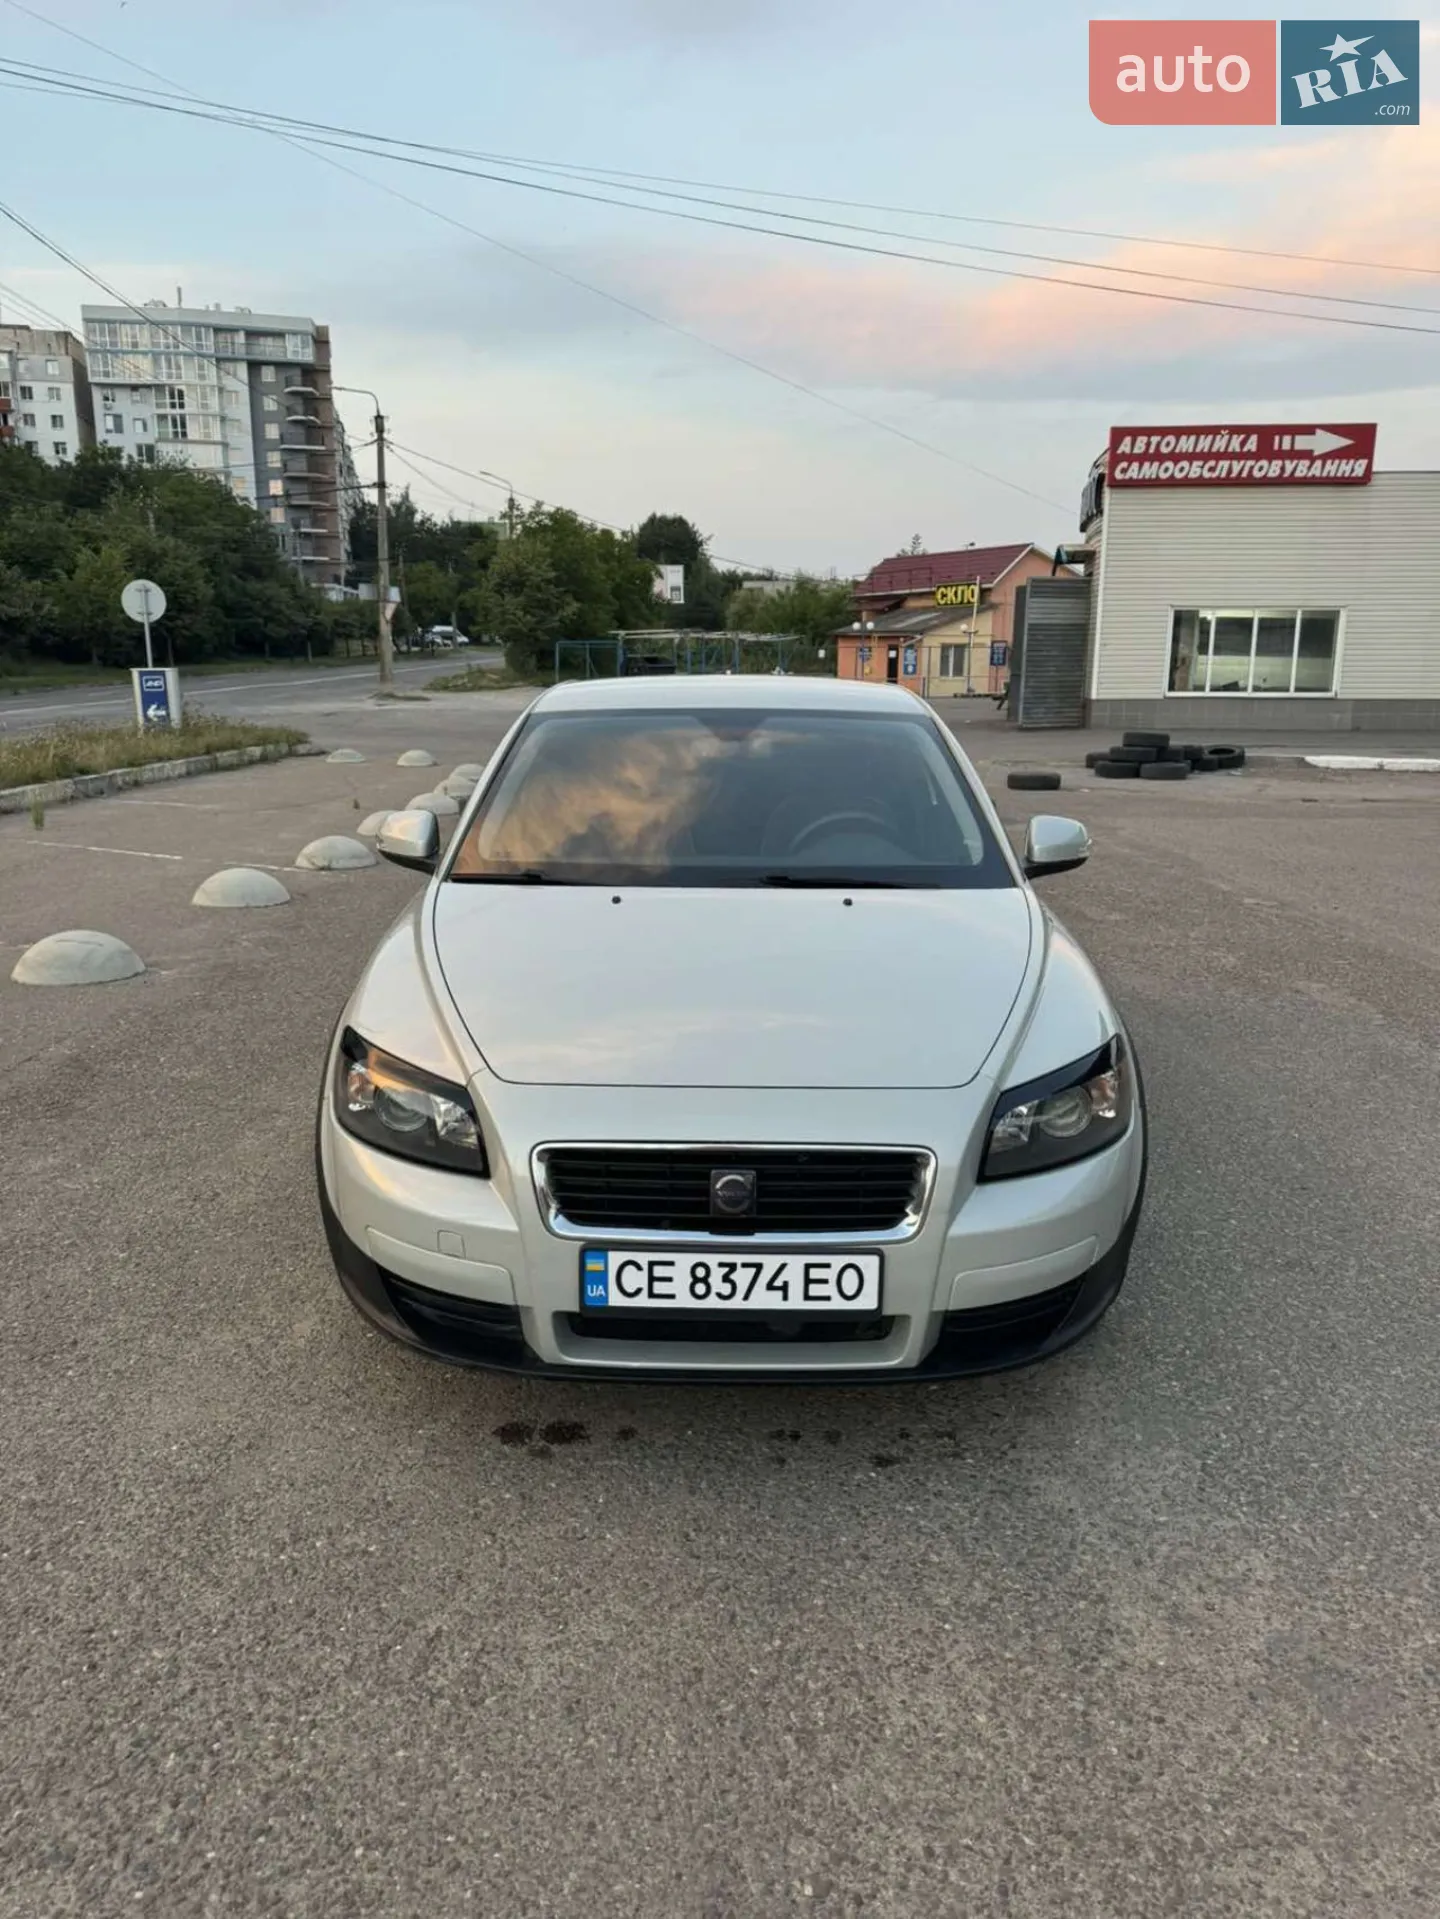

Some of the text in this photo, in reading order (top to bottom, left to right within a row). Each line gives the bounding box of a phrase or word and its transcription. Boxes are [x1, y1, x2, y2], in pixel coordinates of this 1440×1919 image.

[1117, 430, 1258, 454] АВТОМИЙКА
[1114, 459, 1368, 480] САМООБСЛУГОВУВАННЯ
[936, 584, 978, 605] СКЛО
[587, 1284, 606, 1297] UA
[615, 1259, 676, 1300] CE
[689, 1261, 789, 1302] 8374
